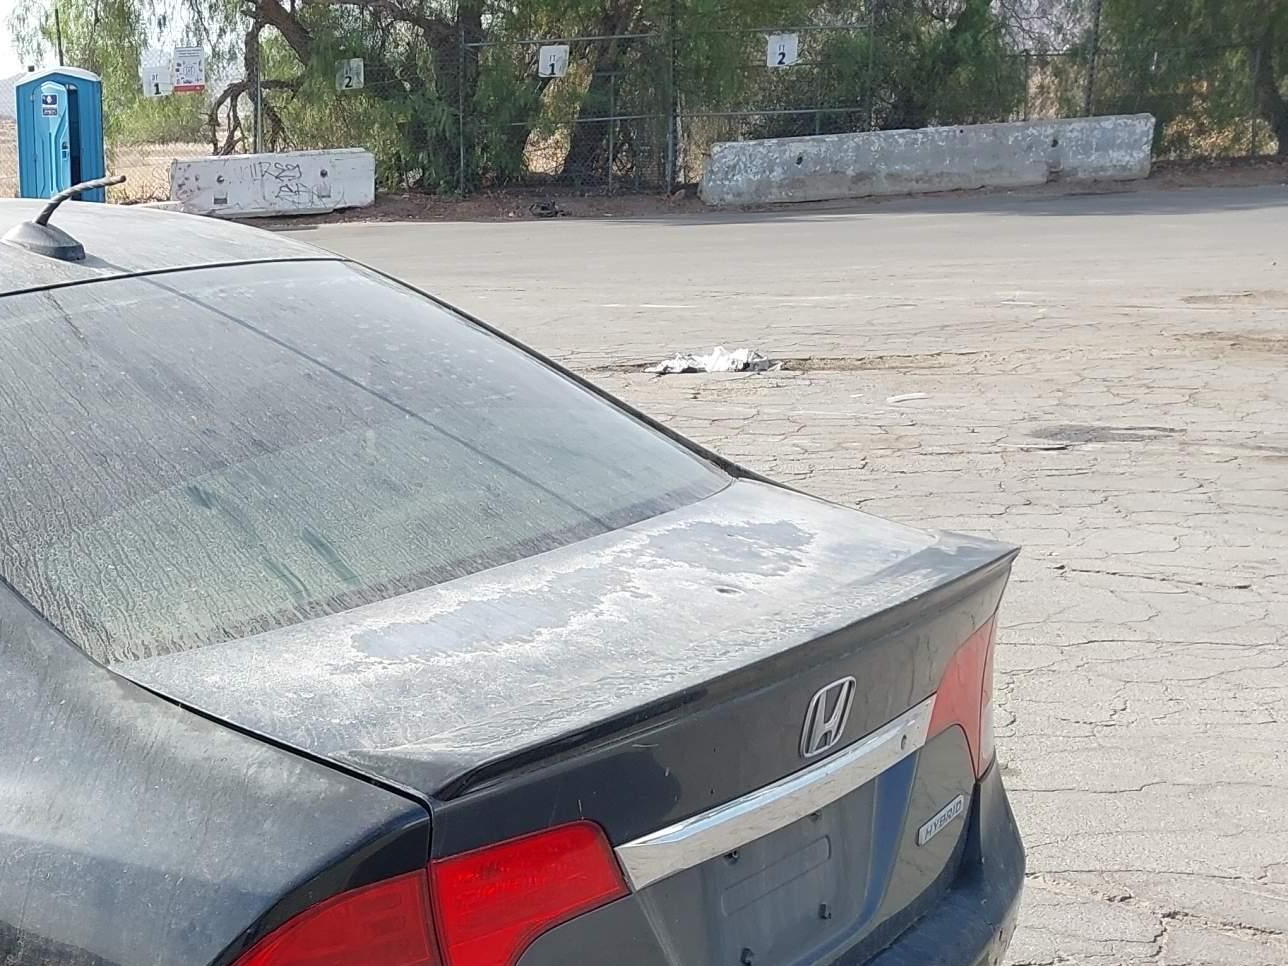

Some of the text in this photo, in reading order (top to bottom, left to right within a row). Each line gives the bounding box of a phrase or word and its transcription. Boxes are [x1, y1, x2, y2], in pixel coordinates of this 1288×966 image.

[777, 52, 786, 65] 2
[549, 62, 556, 75] 1
[345, 75, 353, 88] 2
[154, 82, 161, 95] 1
[923, 799, 963, 841] HYBRID
